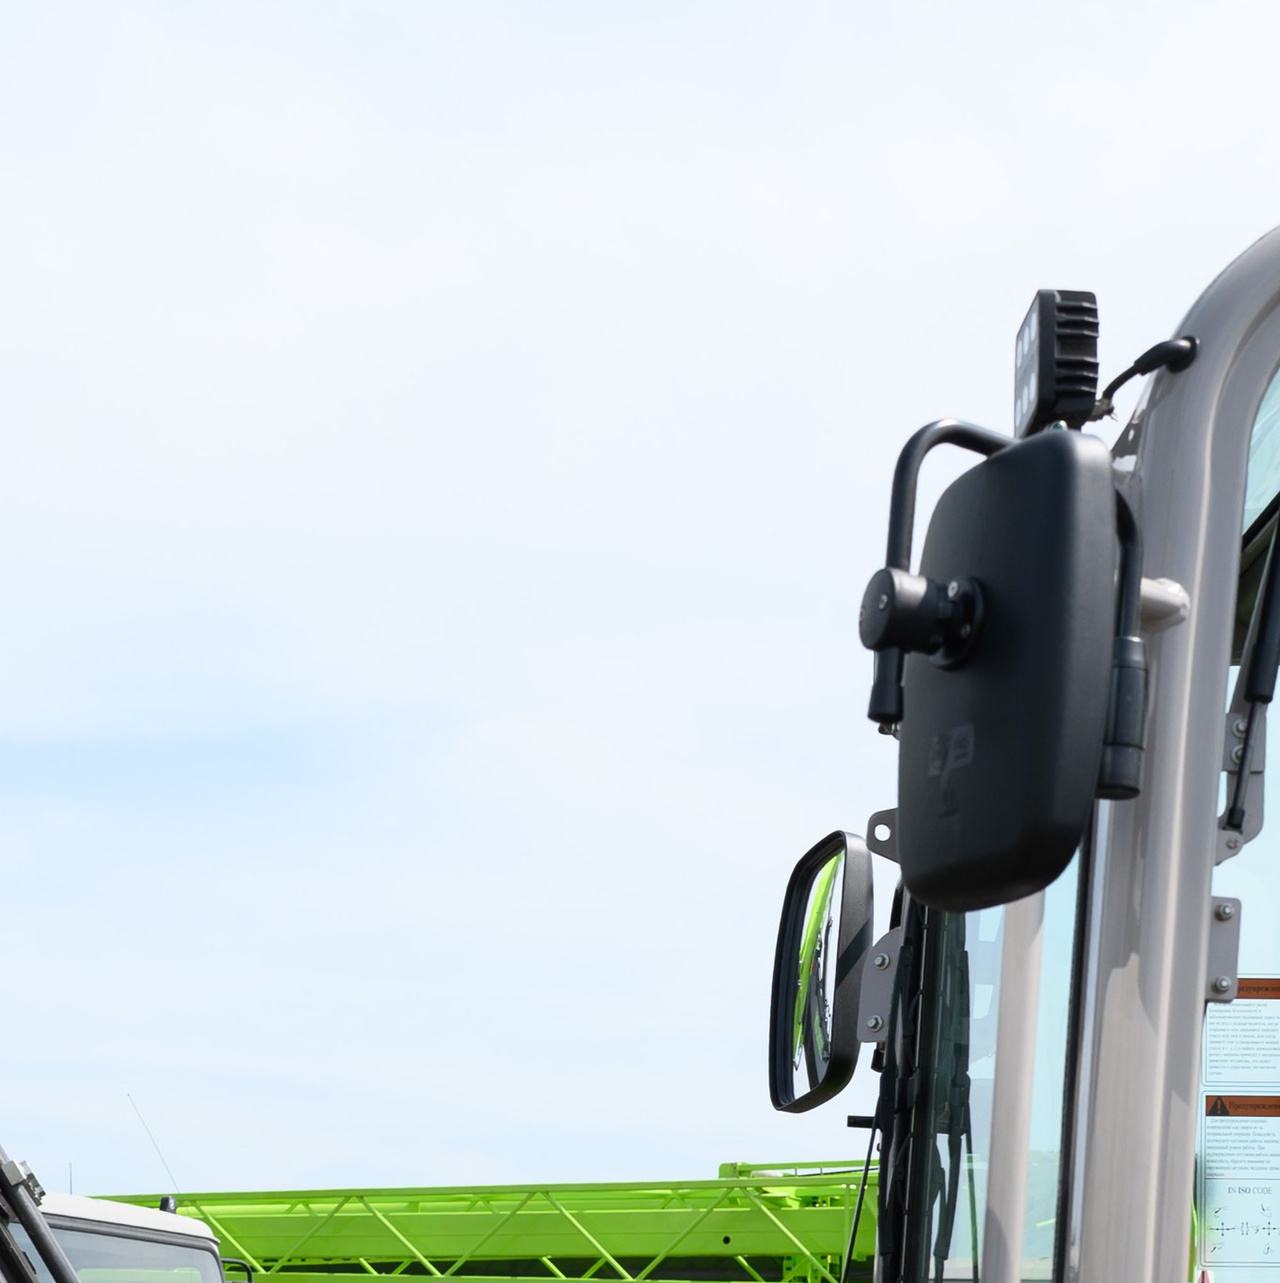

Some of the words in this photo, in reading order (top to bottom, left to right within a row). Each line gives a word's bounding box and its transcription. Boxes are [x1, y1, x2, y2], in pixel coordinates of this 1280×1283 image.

[1228, 1186, 1236, 1194] IN
[1238, 1186, 1251, 1194] ISO
[1252, 1186, 1273, 1194] CODE
